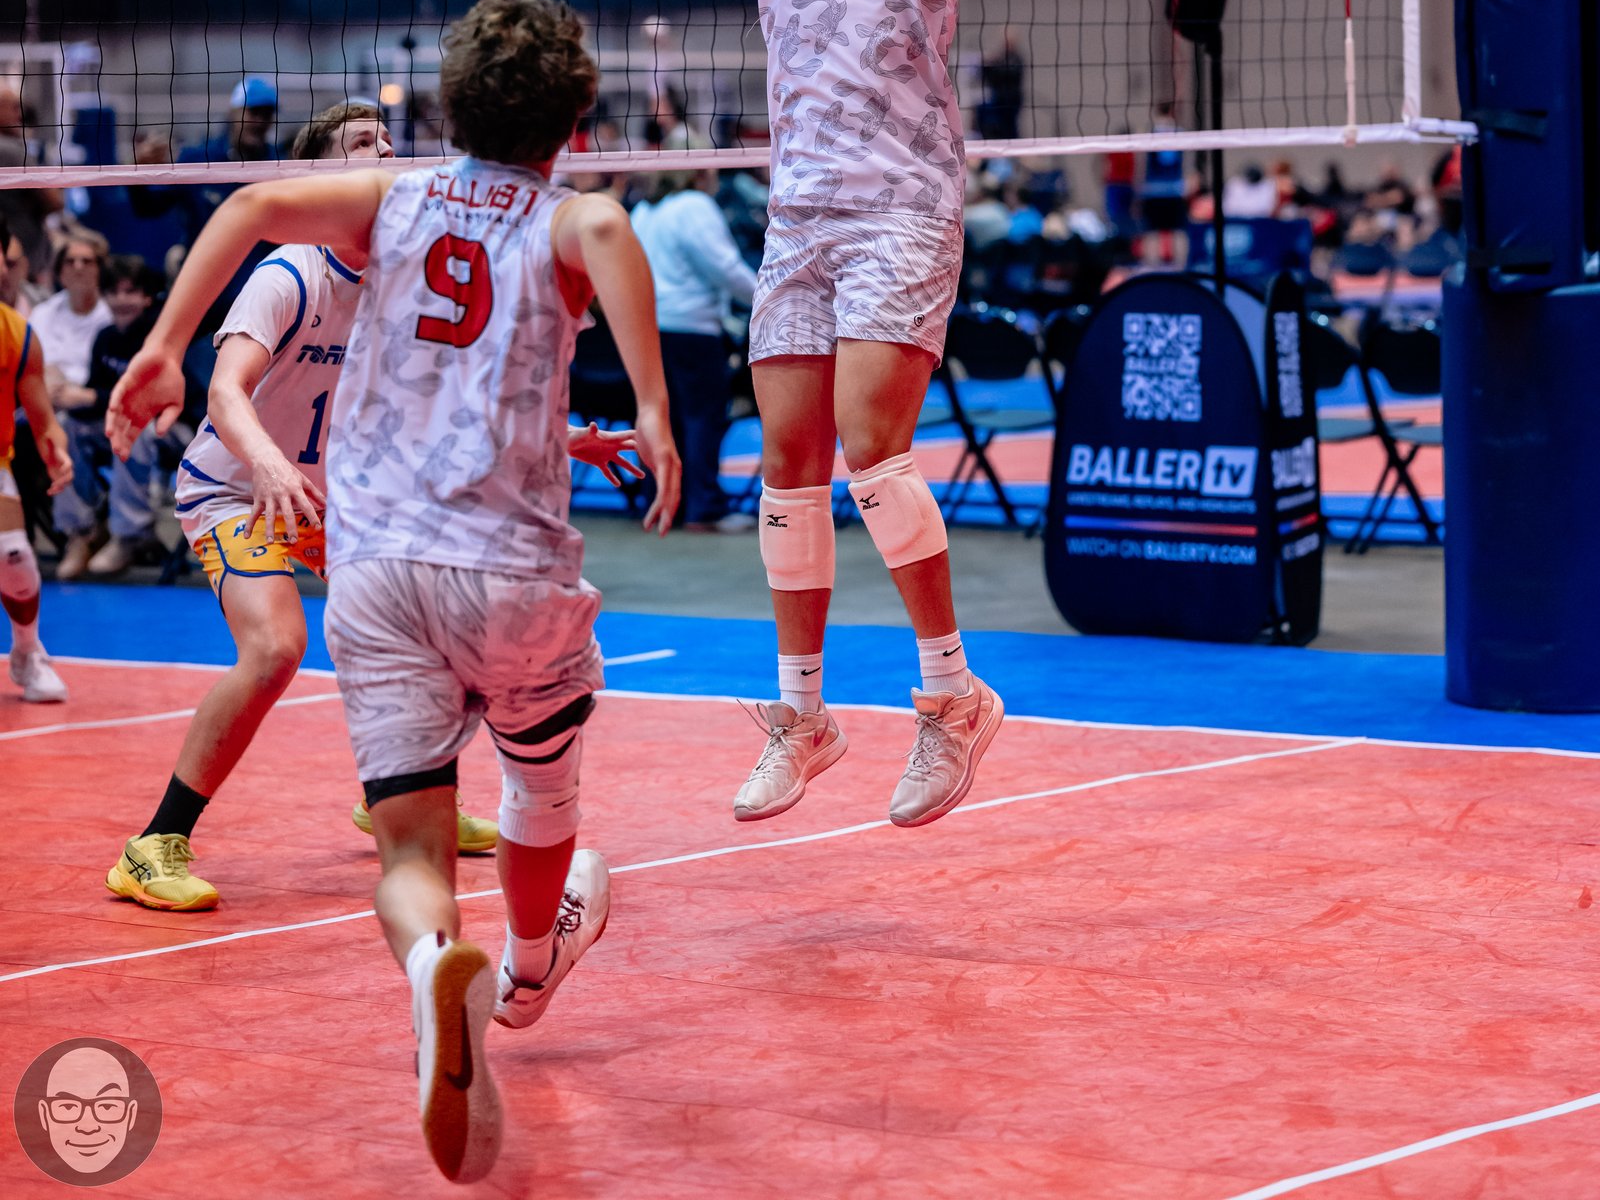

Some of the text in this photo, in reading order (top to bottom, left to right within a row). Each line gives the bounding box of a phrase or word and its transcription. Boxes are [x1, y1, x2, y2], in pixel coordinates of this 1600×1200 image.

[415, 232, 495, 349] 9
[297, 344, 346, 365] TOR
[297, 390, 330, 465] 1
[1067, 445, 1246, 488] BALLER tv
[1066, 536, 1117, 558] WATCH
[1119, 539, 1141, 559] ON
